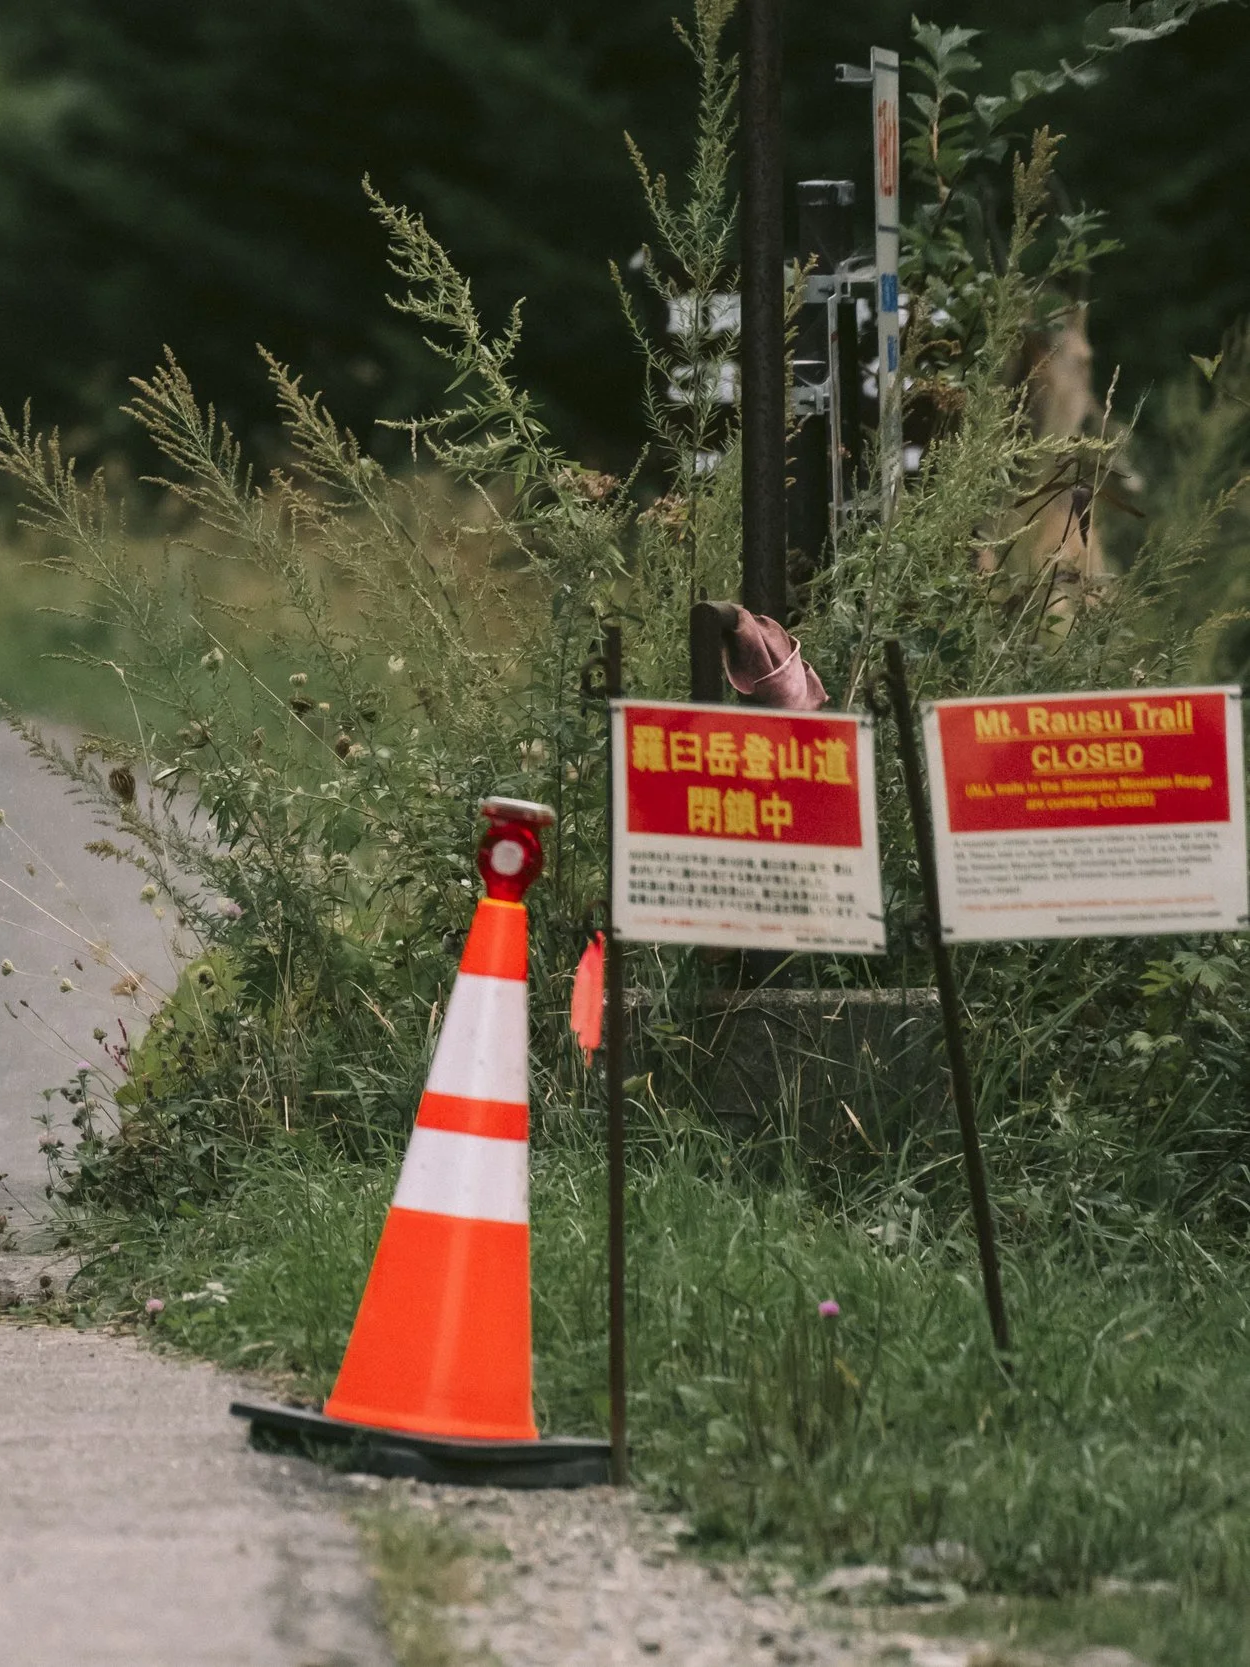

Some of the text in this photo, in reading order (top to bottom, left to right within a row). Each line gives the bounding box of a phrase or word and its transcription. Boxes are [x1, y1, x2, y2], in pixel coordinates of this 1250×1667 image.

[974, 700, 1194, 737] Mt. Rausu Trail
[631, 724, 852, 785] 羅臼岳登山道
[1031, 742, 1144, 770] CLOSED
[687, 786, 793, 839] 閉鎖中
